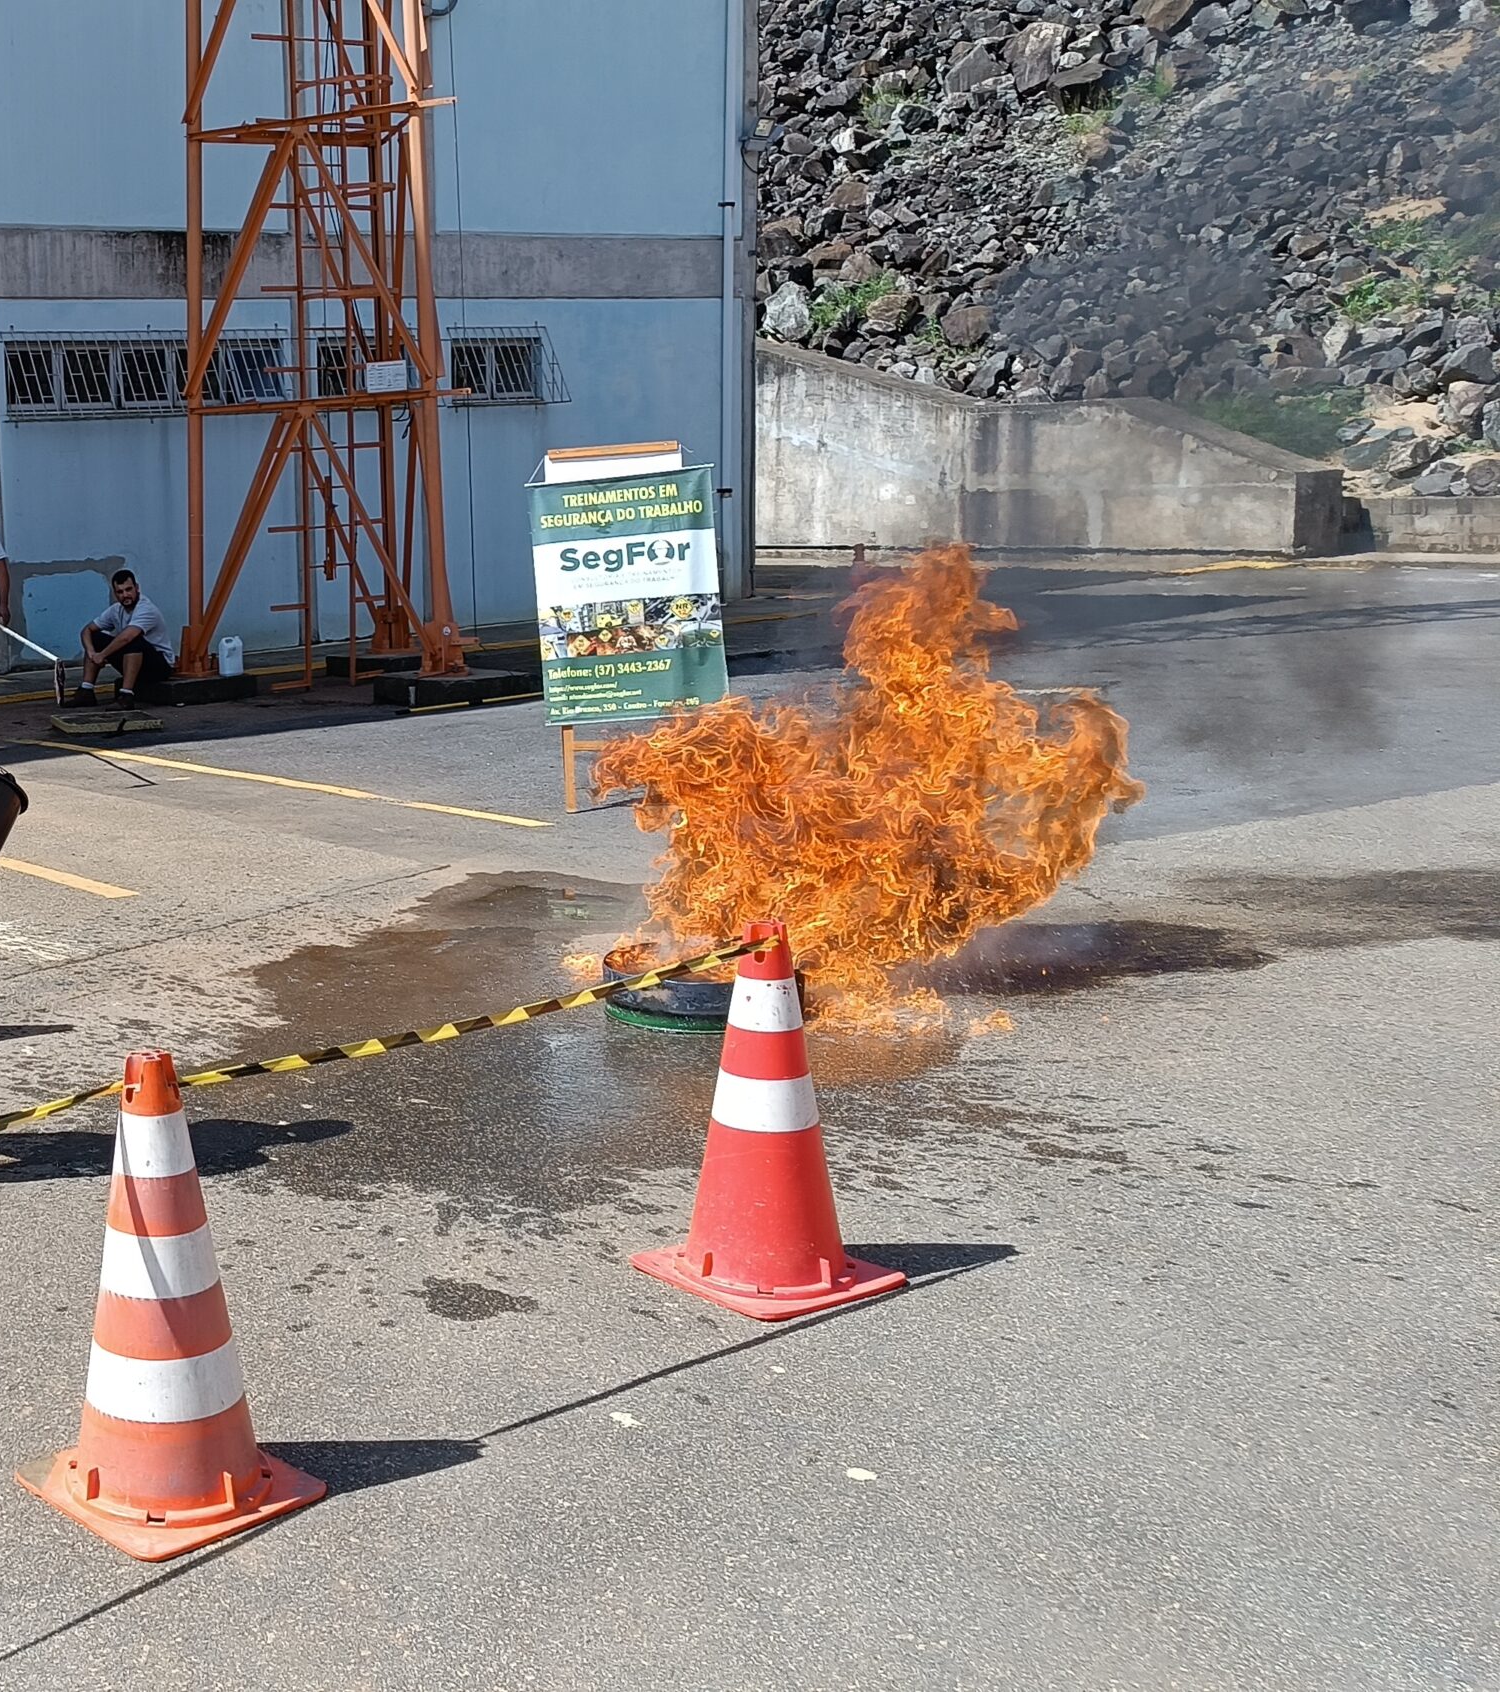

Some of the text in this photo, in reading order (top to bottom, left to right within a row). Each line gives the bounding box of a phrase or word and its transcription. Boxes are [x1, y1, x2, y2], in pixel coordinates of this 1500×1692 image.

[562, 483, 678, 508] TREINAMENTOS EM
[540, 499, 703, 529] SEGURANÇA DO TRABALHO
[547, 658, 672, 680] Telefone: (37) 3443-2367
